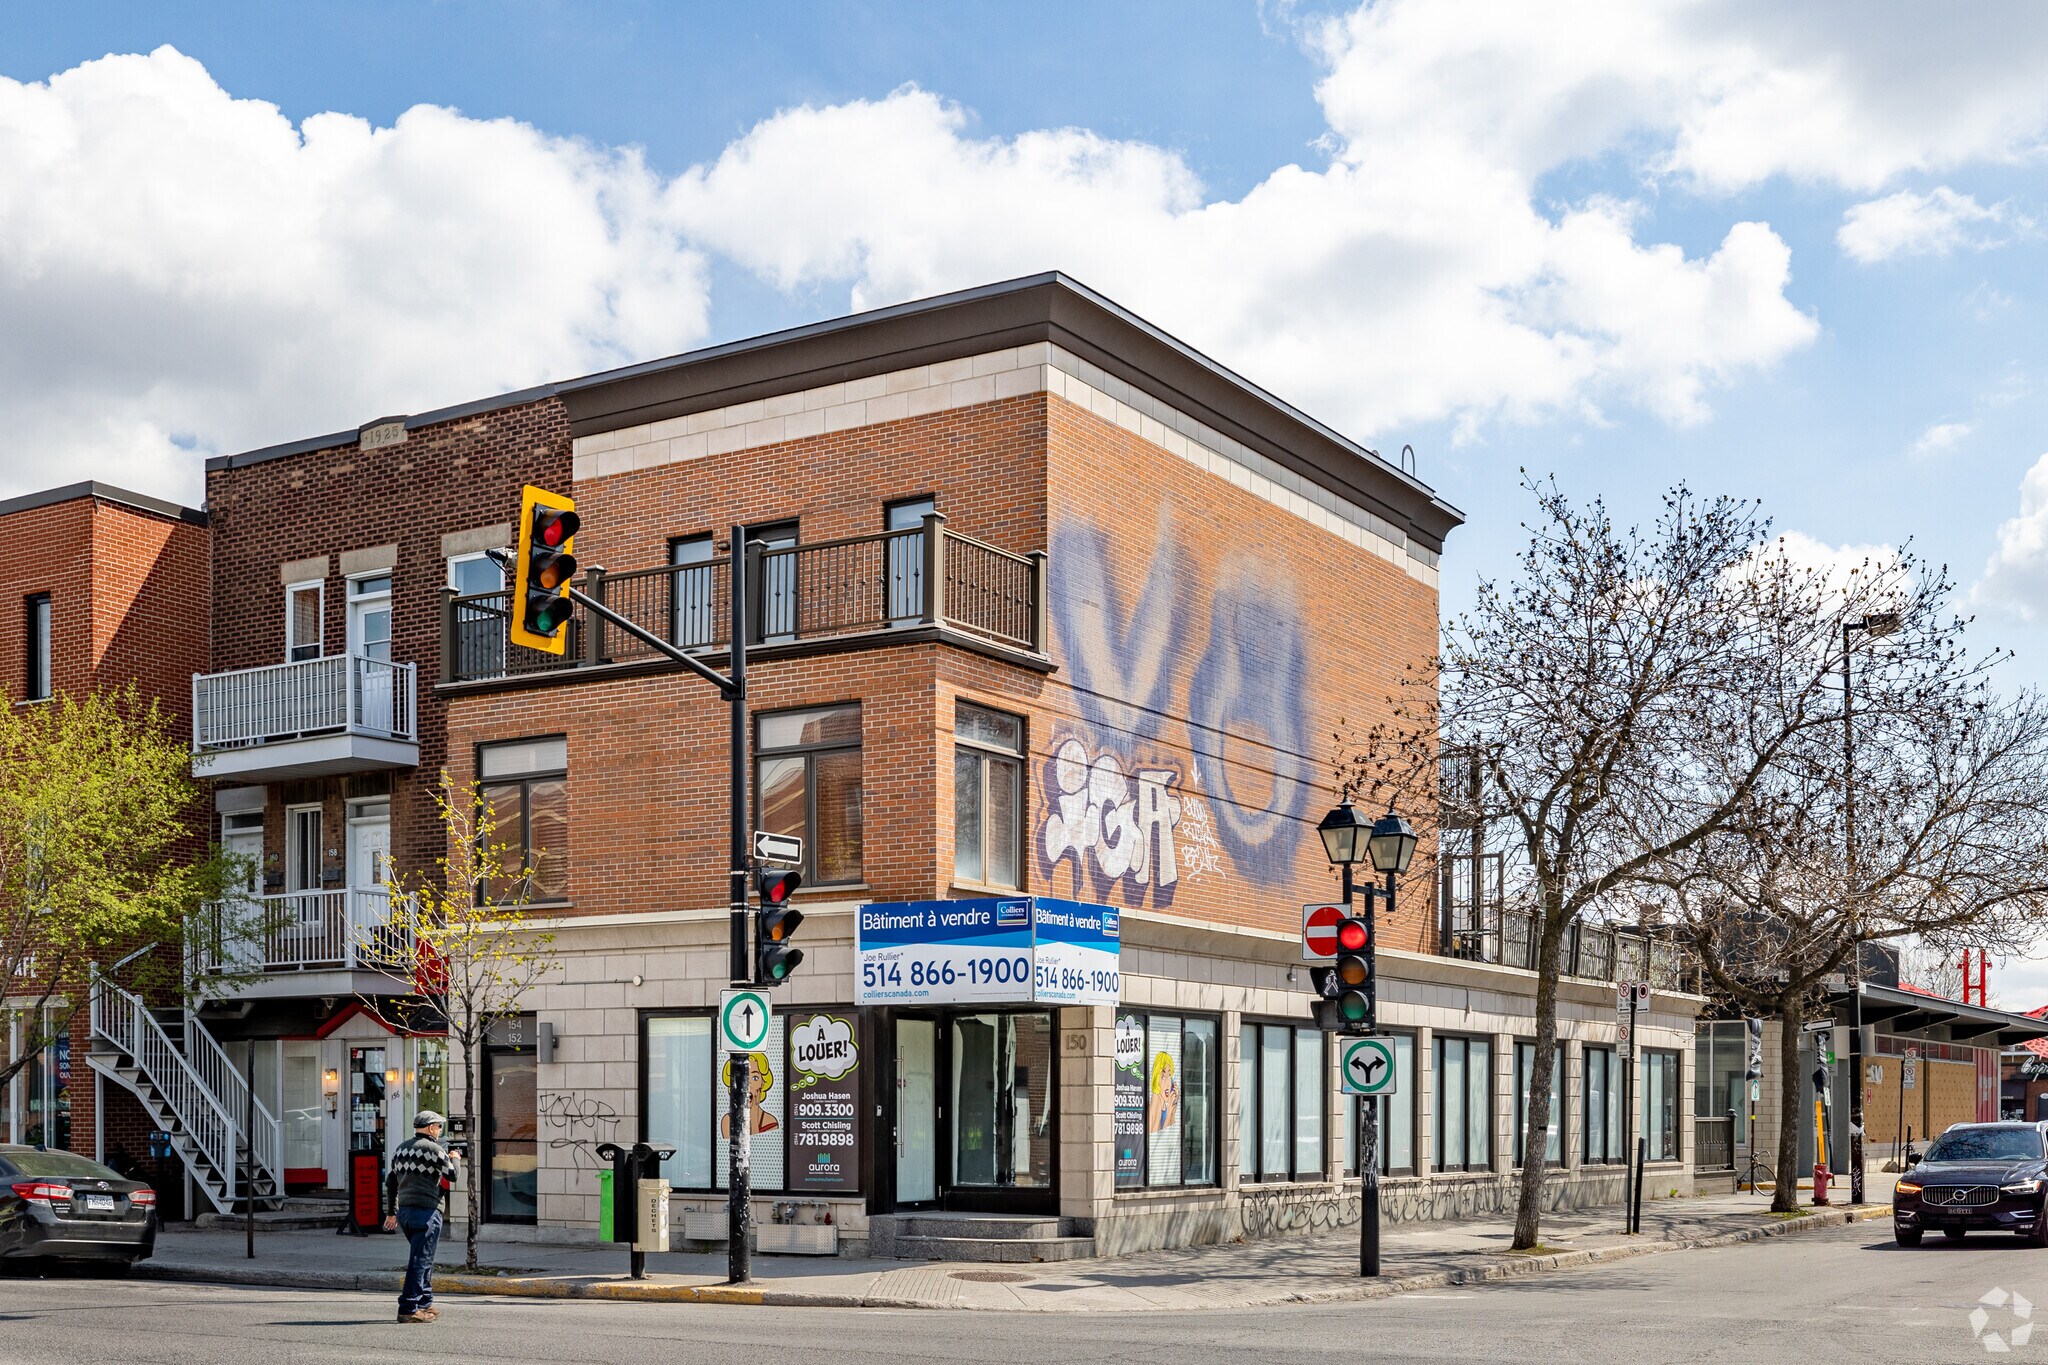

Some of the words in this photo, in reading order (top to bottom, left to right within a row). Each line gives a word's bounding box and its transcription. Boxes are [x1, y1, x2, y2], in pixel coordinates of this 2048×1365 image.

[370, 426, 399, 443] 1925
[328, 848, 338, 857] 158
[1000, 905, 1025, 914] Colliers
[862, 911, 924, 931] Bâtiment
[927, 909, 937, 927] à
[940, 910, 990, 927] vendre
[1036, 908, 1069, 927] Bâtiment
[1069, 912, 1075, 928] à
[1075, 914, 1101, 931] vendre
[863, 953, 877, 962] Joe
[1036, 956, 1045, 965] Joe
[863, 962, 902, 988] 514
[910, 957, 1030, 987] 866-1900
[1035, 965, 1058, 988] 514
[1062, 968, 1119, 993] 866-1900
[863, 988, 930, 998] collierscanada.com
[1035, 989, 1076, 999] collierscanada.com
[508, 1020, 522, 1030] 154
[1125, 1023, 1131, 1036] À
[508, 1033, 522, 1043] 152
[817, 1024, 826, 1041] À
[1065, 1034, 1088, 1050] 150
[1116, 1038, 1141, 1054] LOUER!
[798, 1039, 848, 1062] LOUER!
[1116, 1084, 1130, 1092] Joshua
[801, 1092, 827, 1100] Joshua
[828, 1092, 851, 1100] Hasen
[1114, 1094, 1144, 1107] 909.3300
[799, 1103, 854, 1116] 909.3300
[1115, 1111, 1126, 1119] Scott
[801, 1121, 821, 1129] Scott
[822, 1121, 851, 1131] Chisling
[1114, 1122, 1144, 1135] 781.9898
[799, 1133, 854, 1146] 781.9898
[808, 1163, 840, 1172] aurora
